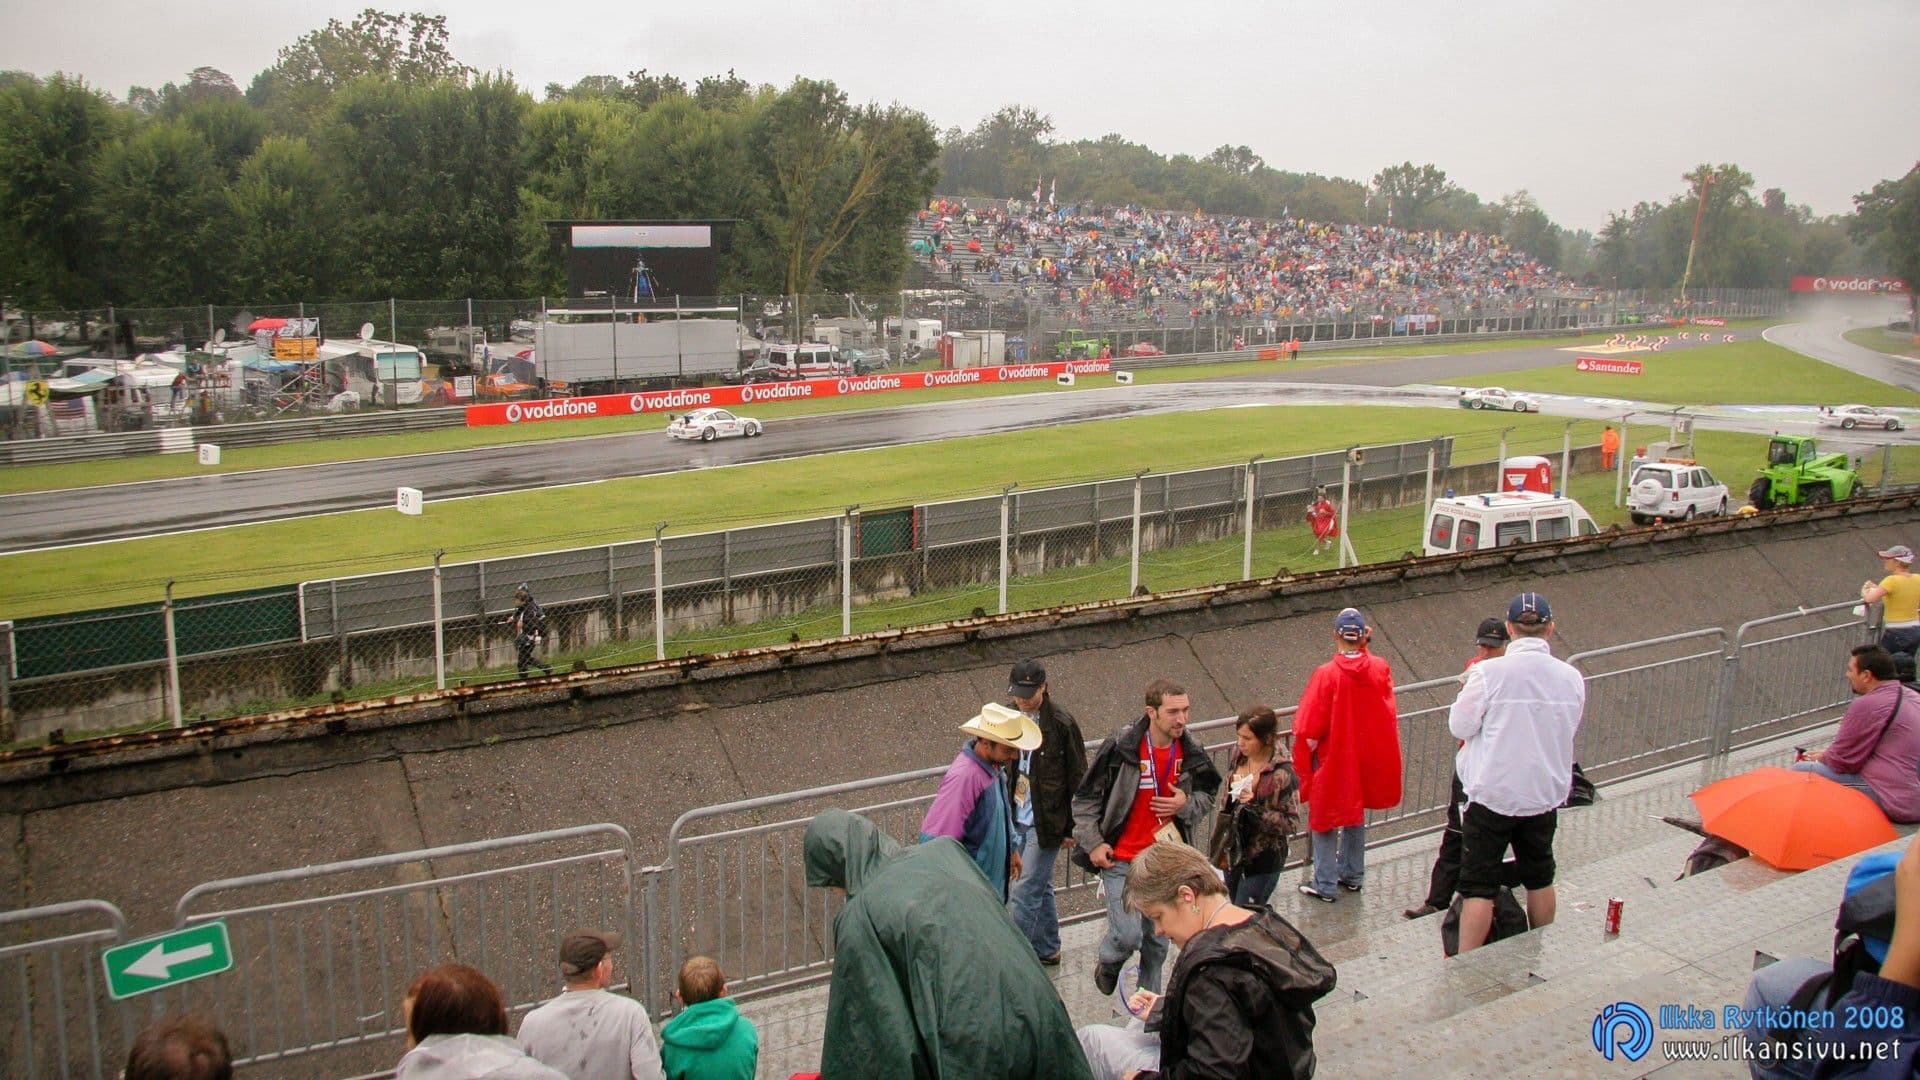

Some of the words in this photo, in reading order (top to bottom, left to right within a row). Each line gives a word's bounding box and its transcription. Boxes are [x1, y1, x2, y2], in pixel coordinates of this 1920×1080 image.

[1008, 366, 1049, 379] vodafone
[1073, 361, 1110, 374] vodafone
[1589, 360, 1640, 374] Santander
[850, 376, 901, 391] vodafone
[935, 370, 980, 385] vodafone
[755, 382, 812, 400] vodafone
[645, 390, 711, 409] vodafone
[523, 399, 597, 419] vodafone
[400, 492, 409, 507] 50
